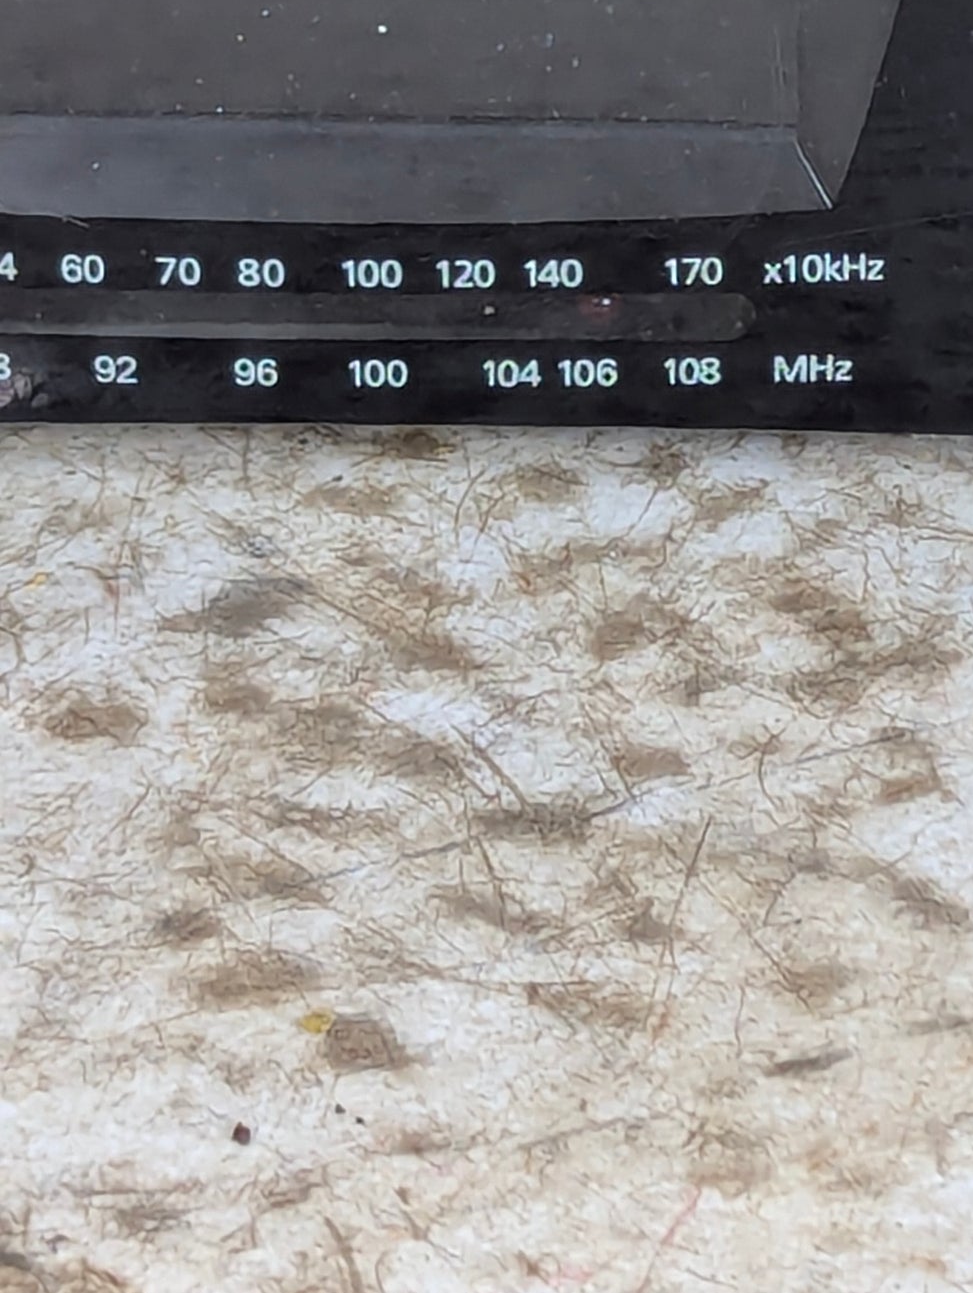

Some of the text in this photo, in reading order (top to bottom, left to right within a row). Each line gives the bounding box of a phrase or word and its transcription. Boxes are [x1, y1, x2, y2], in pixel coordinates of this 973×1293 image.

[60, 254, 105, 284] 60
[154, 255, 201, 286] 70
[237, 258, 285, 288] 80
[341, 259, 402, 288] 100
[435, 259, 496, 288] 120
[523, 259, 584, 288] 140
[664, 256, 723, 285] 170
[763, 252, 886, 284] x10kHz
[93, 355, 139, 384] 92
[233, 358, 279, 387] 96
[347, 359, 408, 388] 100
[482, 359, 541, 388] 104
[557, 358, 619, 387] 106
[664, 357, 722, 385] 108
[772, 355, 854, 383] MHz
